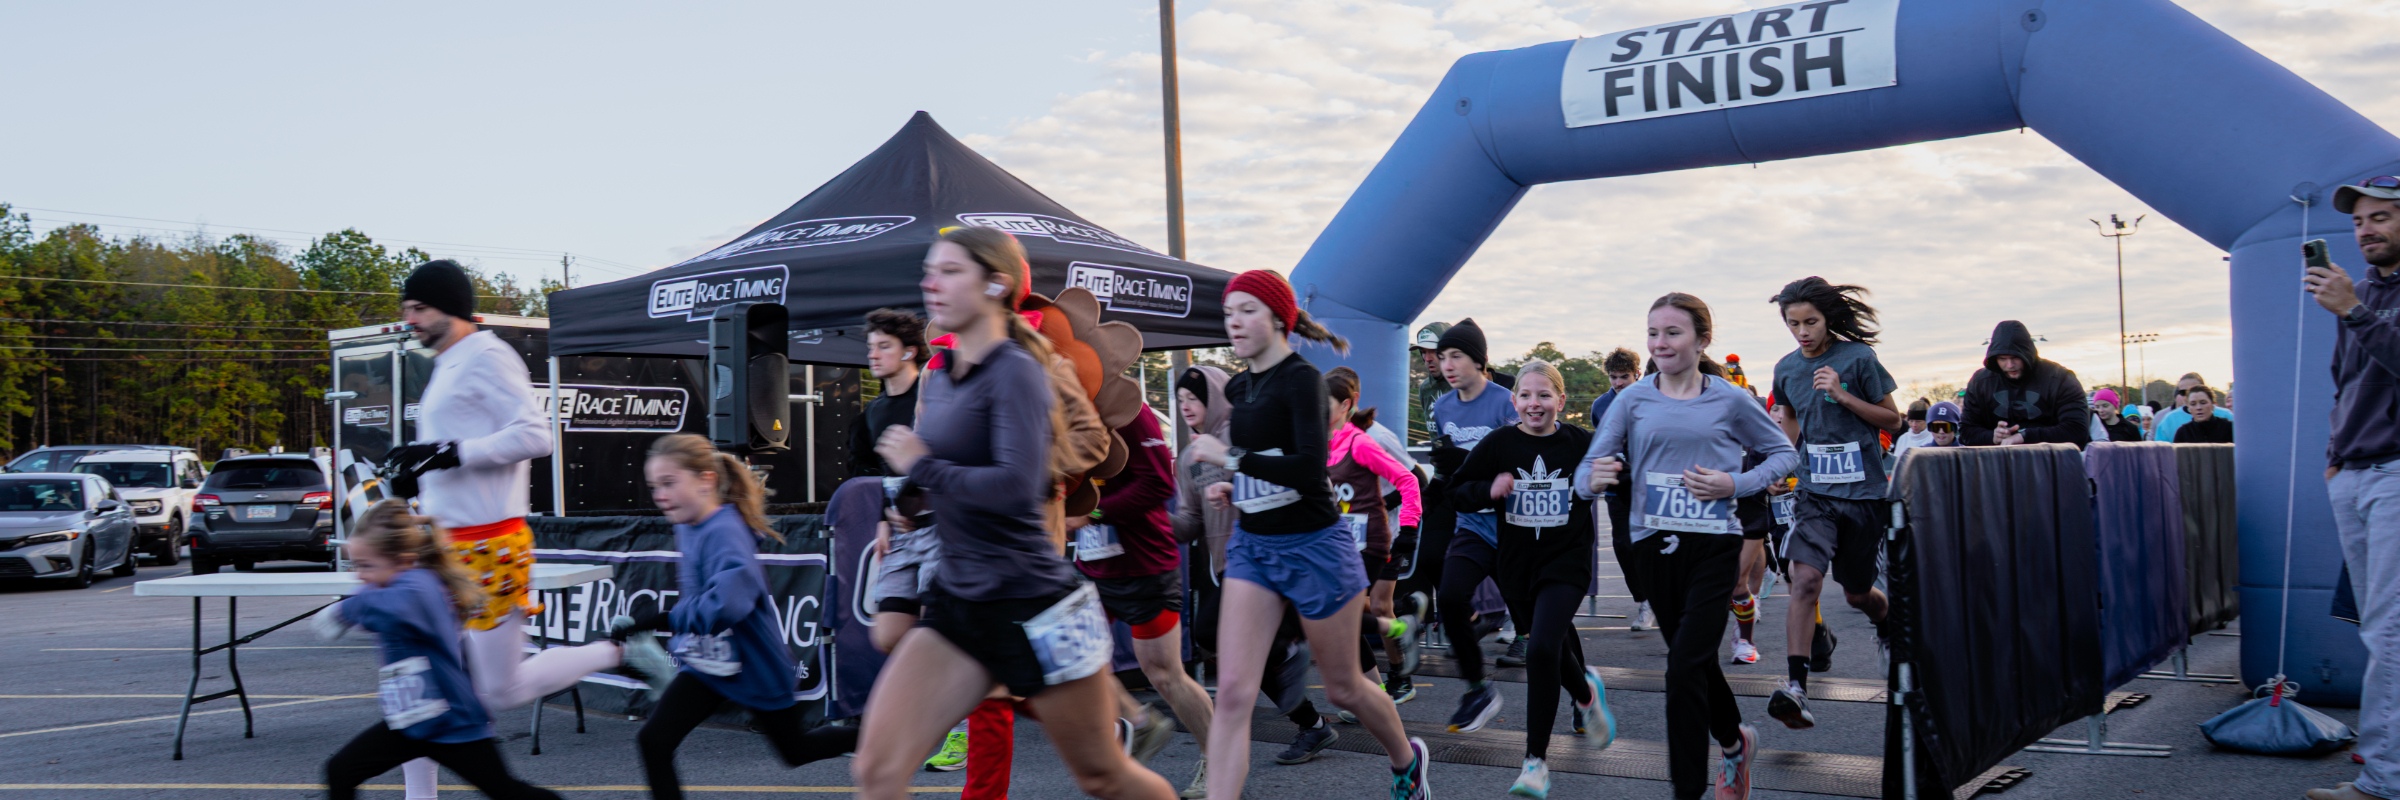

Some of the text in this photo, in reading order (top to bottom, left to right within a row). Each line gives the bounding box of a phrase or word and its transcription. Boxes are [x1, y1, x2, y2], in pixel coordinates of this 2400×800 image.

[1610, 0, 1850, 63] START
[1604, 36, 1847, 117] FINISH
[656, 287, 697, 308] ELITE
[696, 282, 732, 303] RACE
[733, 277, 782, 299] TIMING
[1114, 274, 1146, 297] RACE
[1147, 279, 1188, 301] TIMING
[575, 393, 622, 415] RACE
[624, 394, 680, 416] TIMING
[1813, 452, 1856, 474] 7714
[1511, 491, 1562, 516] 7668
[1656, 487, 1718, 519] 7652
